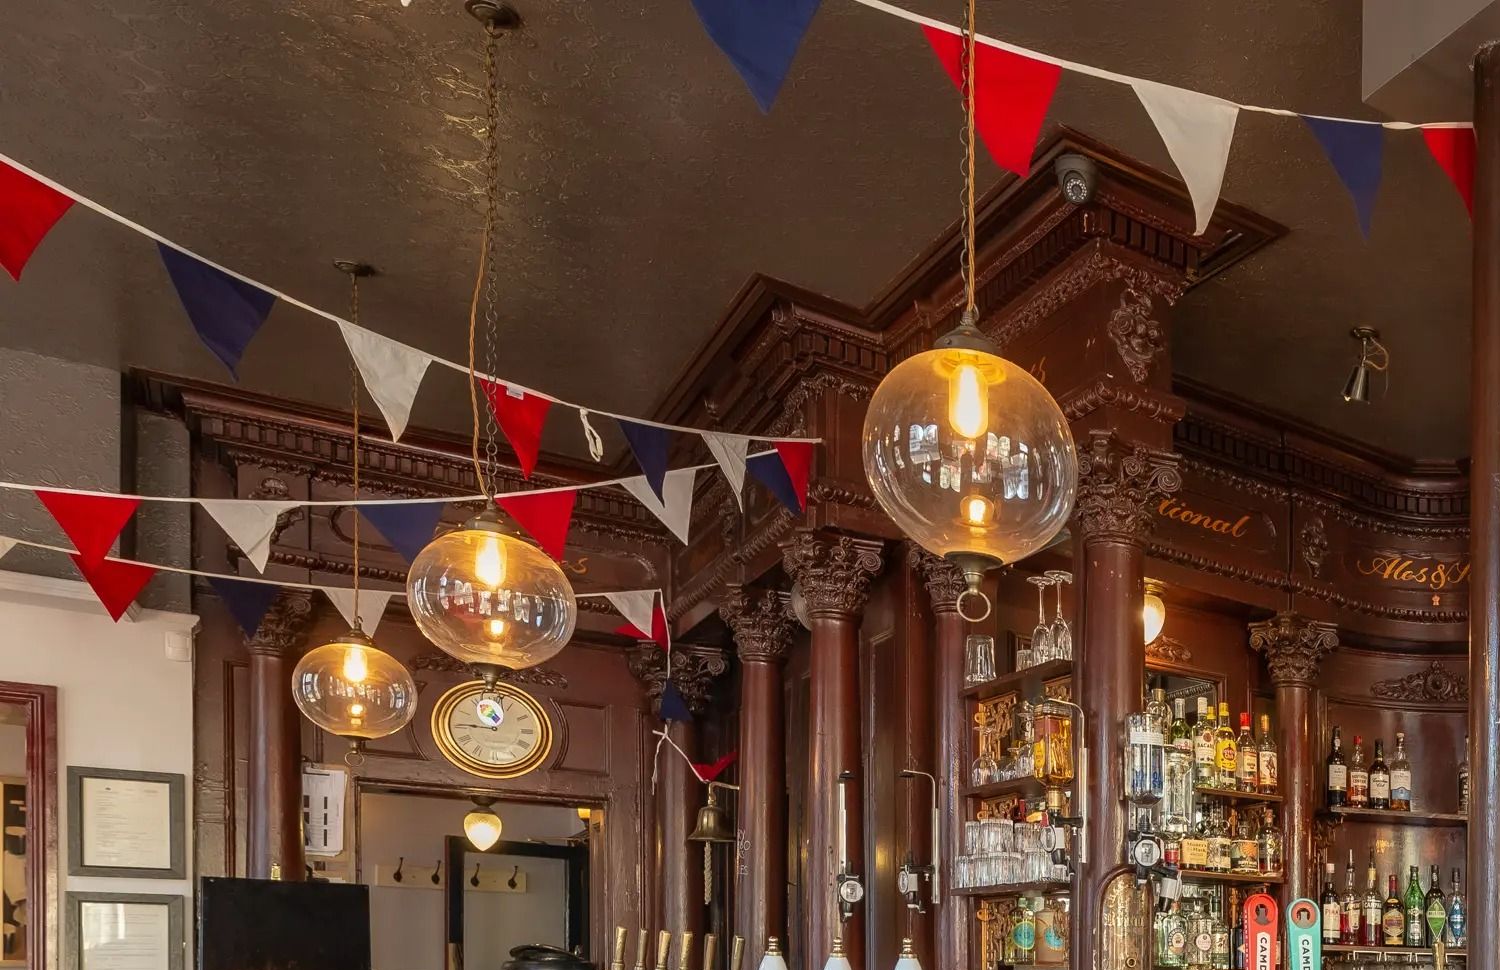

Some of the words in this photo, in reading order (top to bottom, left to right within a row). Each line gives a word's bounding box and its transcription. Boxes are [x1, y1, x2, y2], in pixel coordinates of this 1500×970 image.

[1156, 496, 1252, 539] tional
[1357, 554, 1427, 586] Ales
[1428, 563, 1448, 589] &
